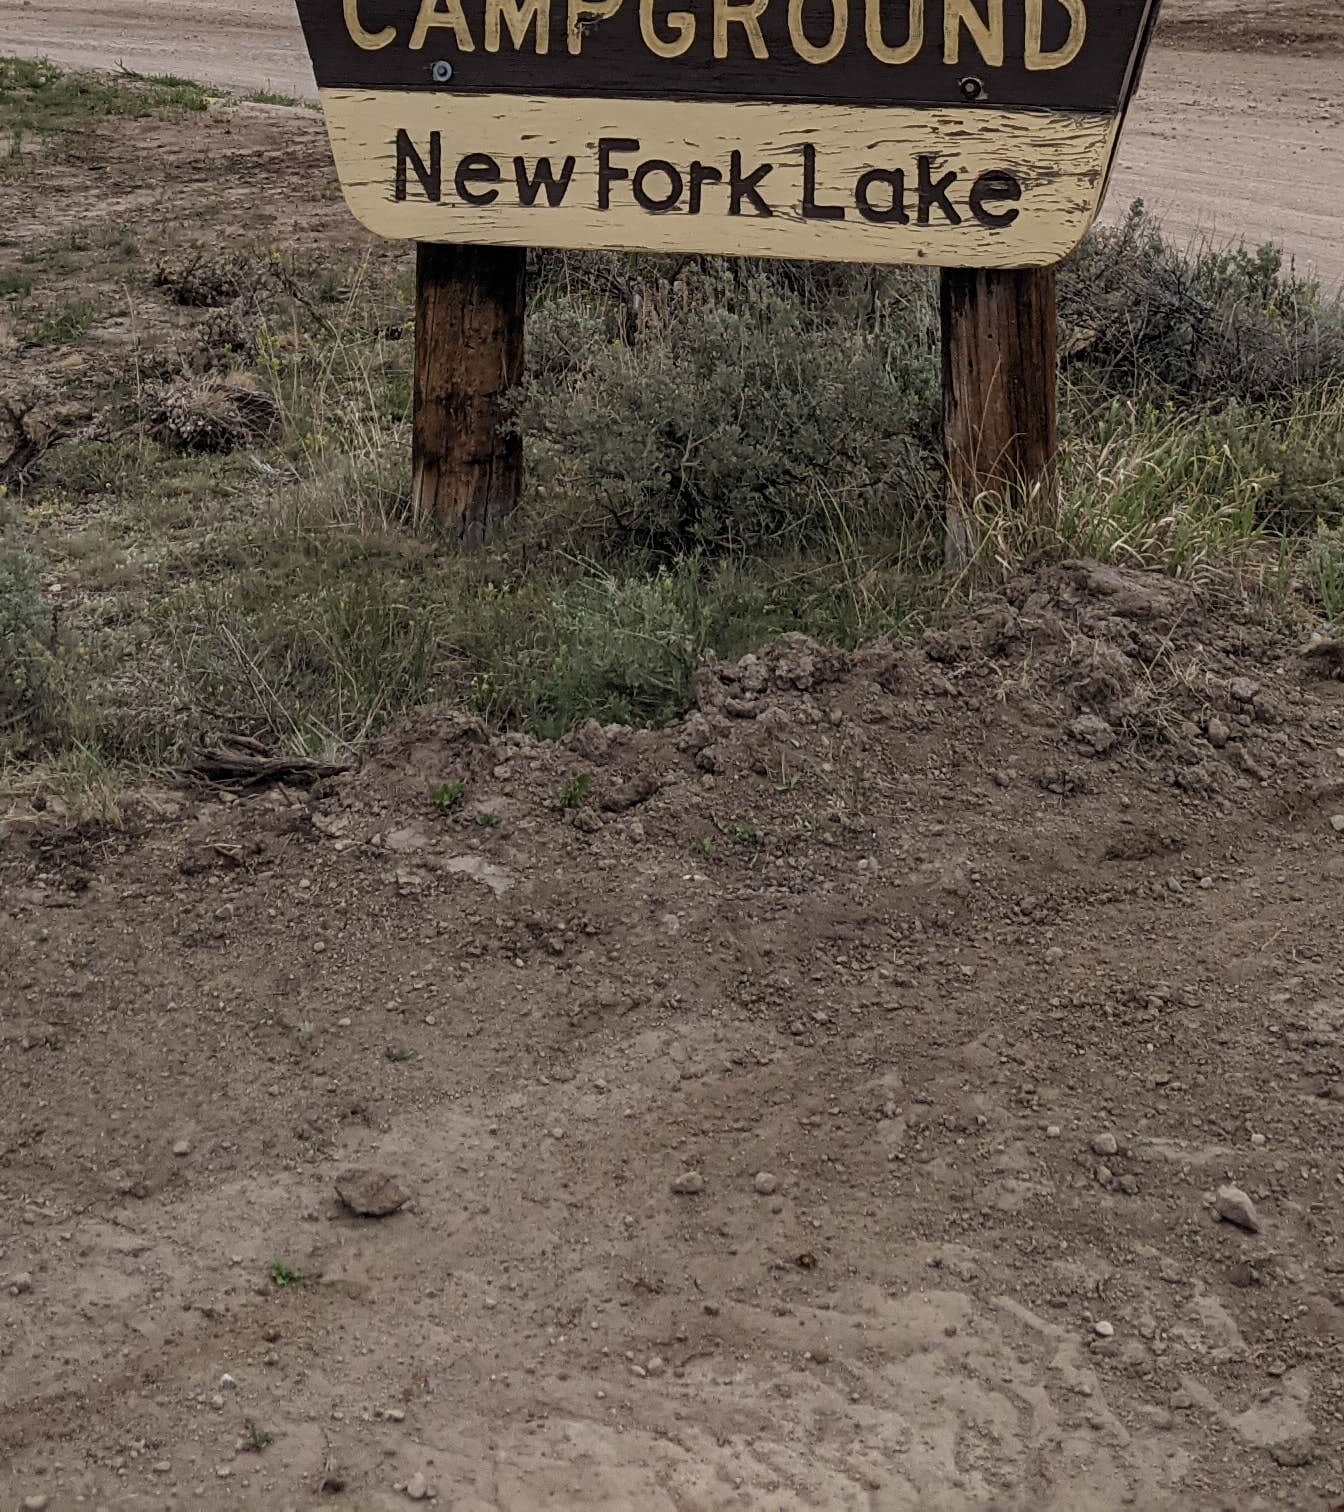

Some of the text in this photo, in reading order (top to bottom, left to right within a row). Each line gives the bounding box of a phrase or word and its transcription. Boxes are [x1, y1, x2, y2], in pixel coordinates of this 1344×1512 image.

[395, 130, 1021, 227] New Fork Lake
